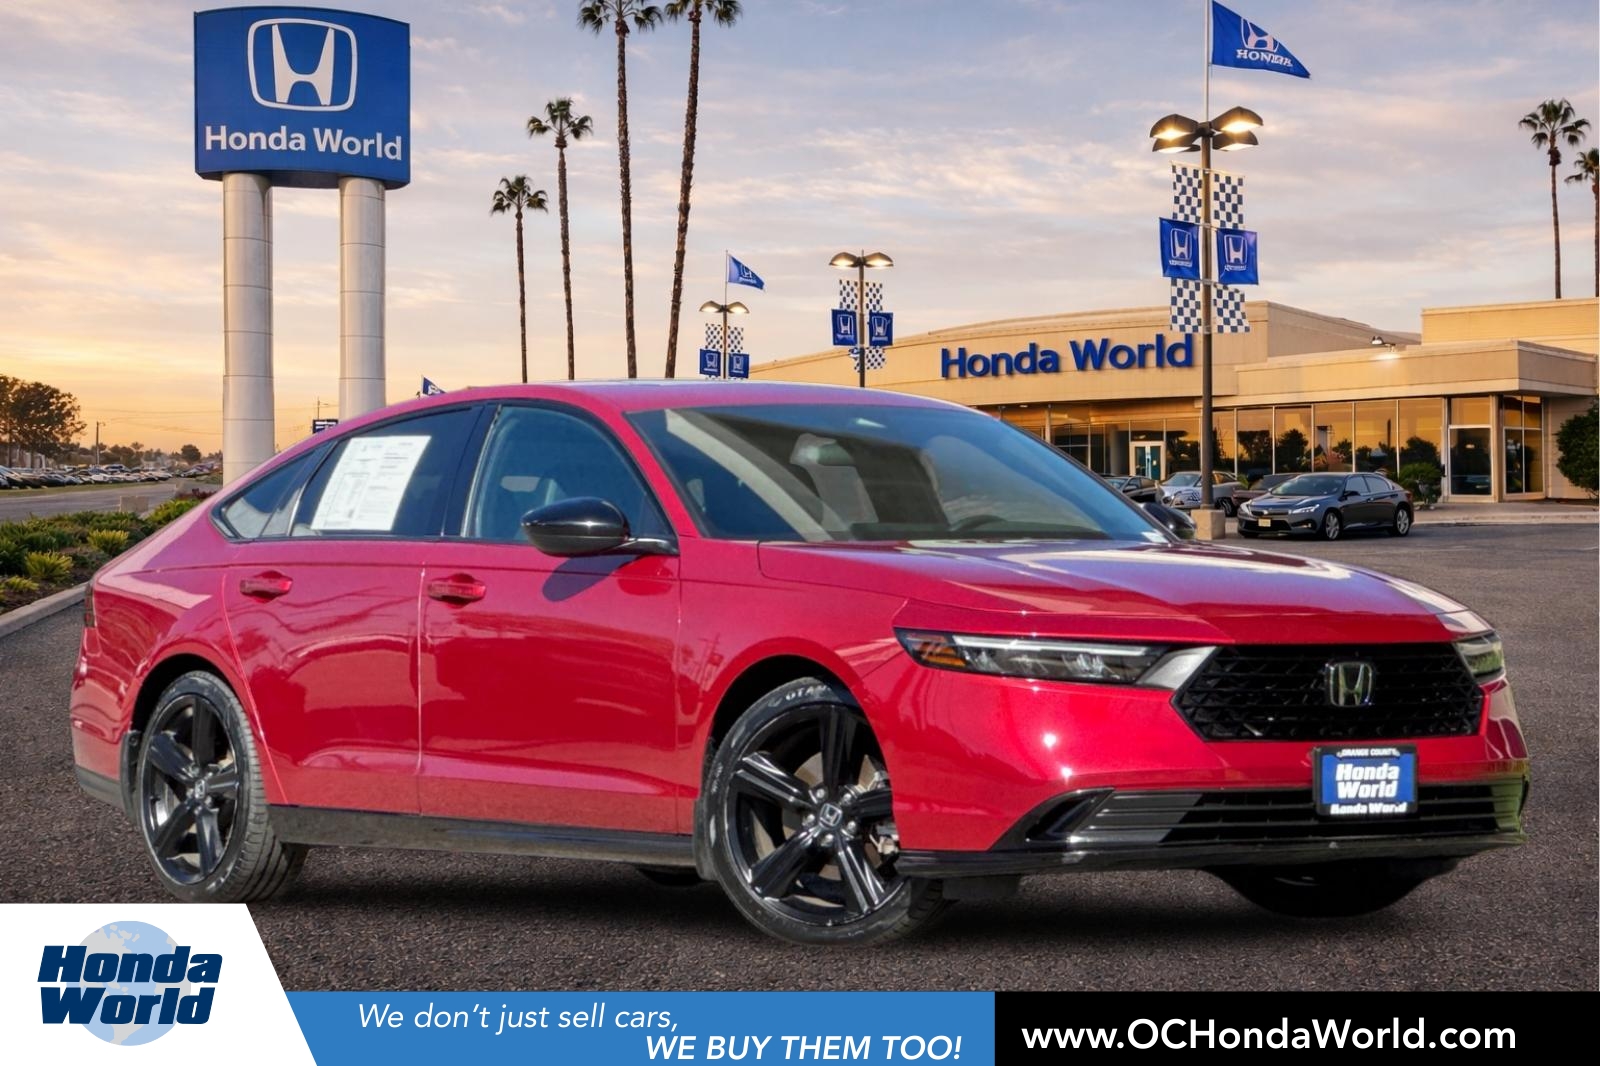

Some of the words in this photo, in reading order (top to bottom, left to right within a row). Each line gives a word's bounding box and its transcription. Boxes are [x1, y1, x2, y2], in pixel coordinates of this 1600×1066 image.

[205, 125, 306, 151] Honda
[313, 127, 402, 160] World
[941, 343, 1060, 378] Honda
[1069, 333, 1194, 370] World
[1335, 762, 1400, 781] Honda
[1337, 780, 1399, 799] World
[1368, 802, 1408, 814] World
